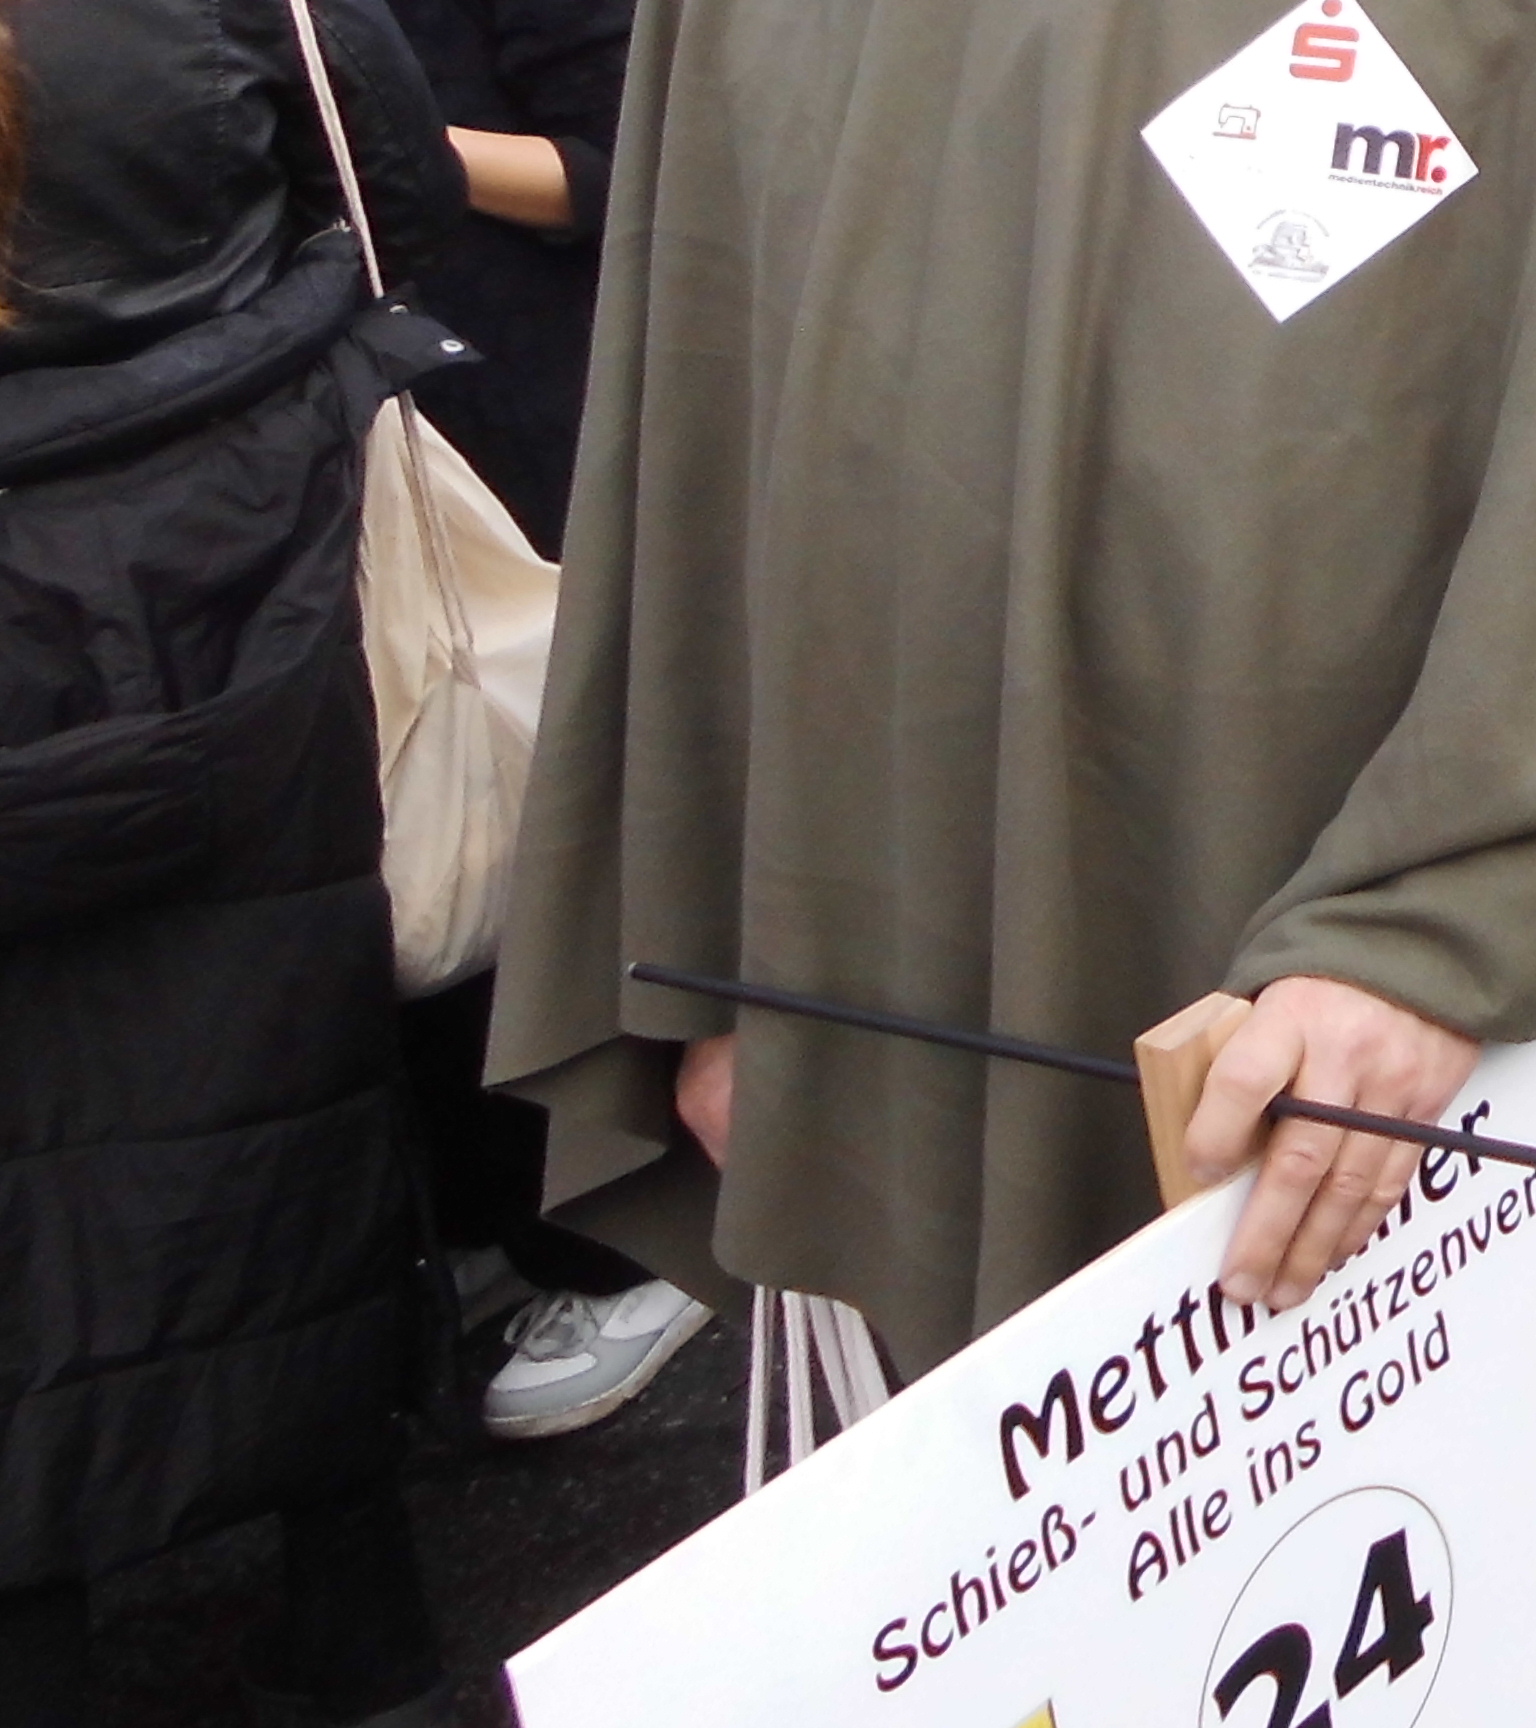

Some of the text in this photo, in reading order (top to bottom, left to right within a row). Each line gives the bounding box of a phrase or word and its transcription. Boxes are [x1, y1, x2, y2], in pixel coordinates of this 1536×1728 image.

[1330, 121, 1452, 184] mr.
[871, 1502, 1098, 1693] Schieß-
[1118, 1391, 1222, 1512] und
[1126, 1309, 1452, 1602] Alle ins Gold
[1212, 1527, 1435, 1728] 24
